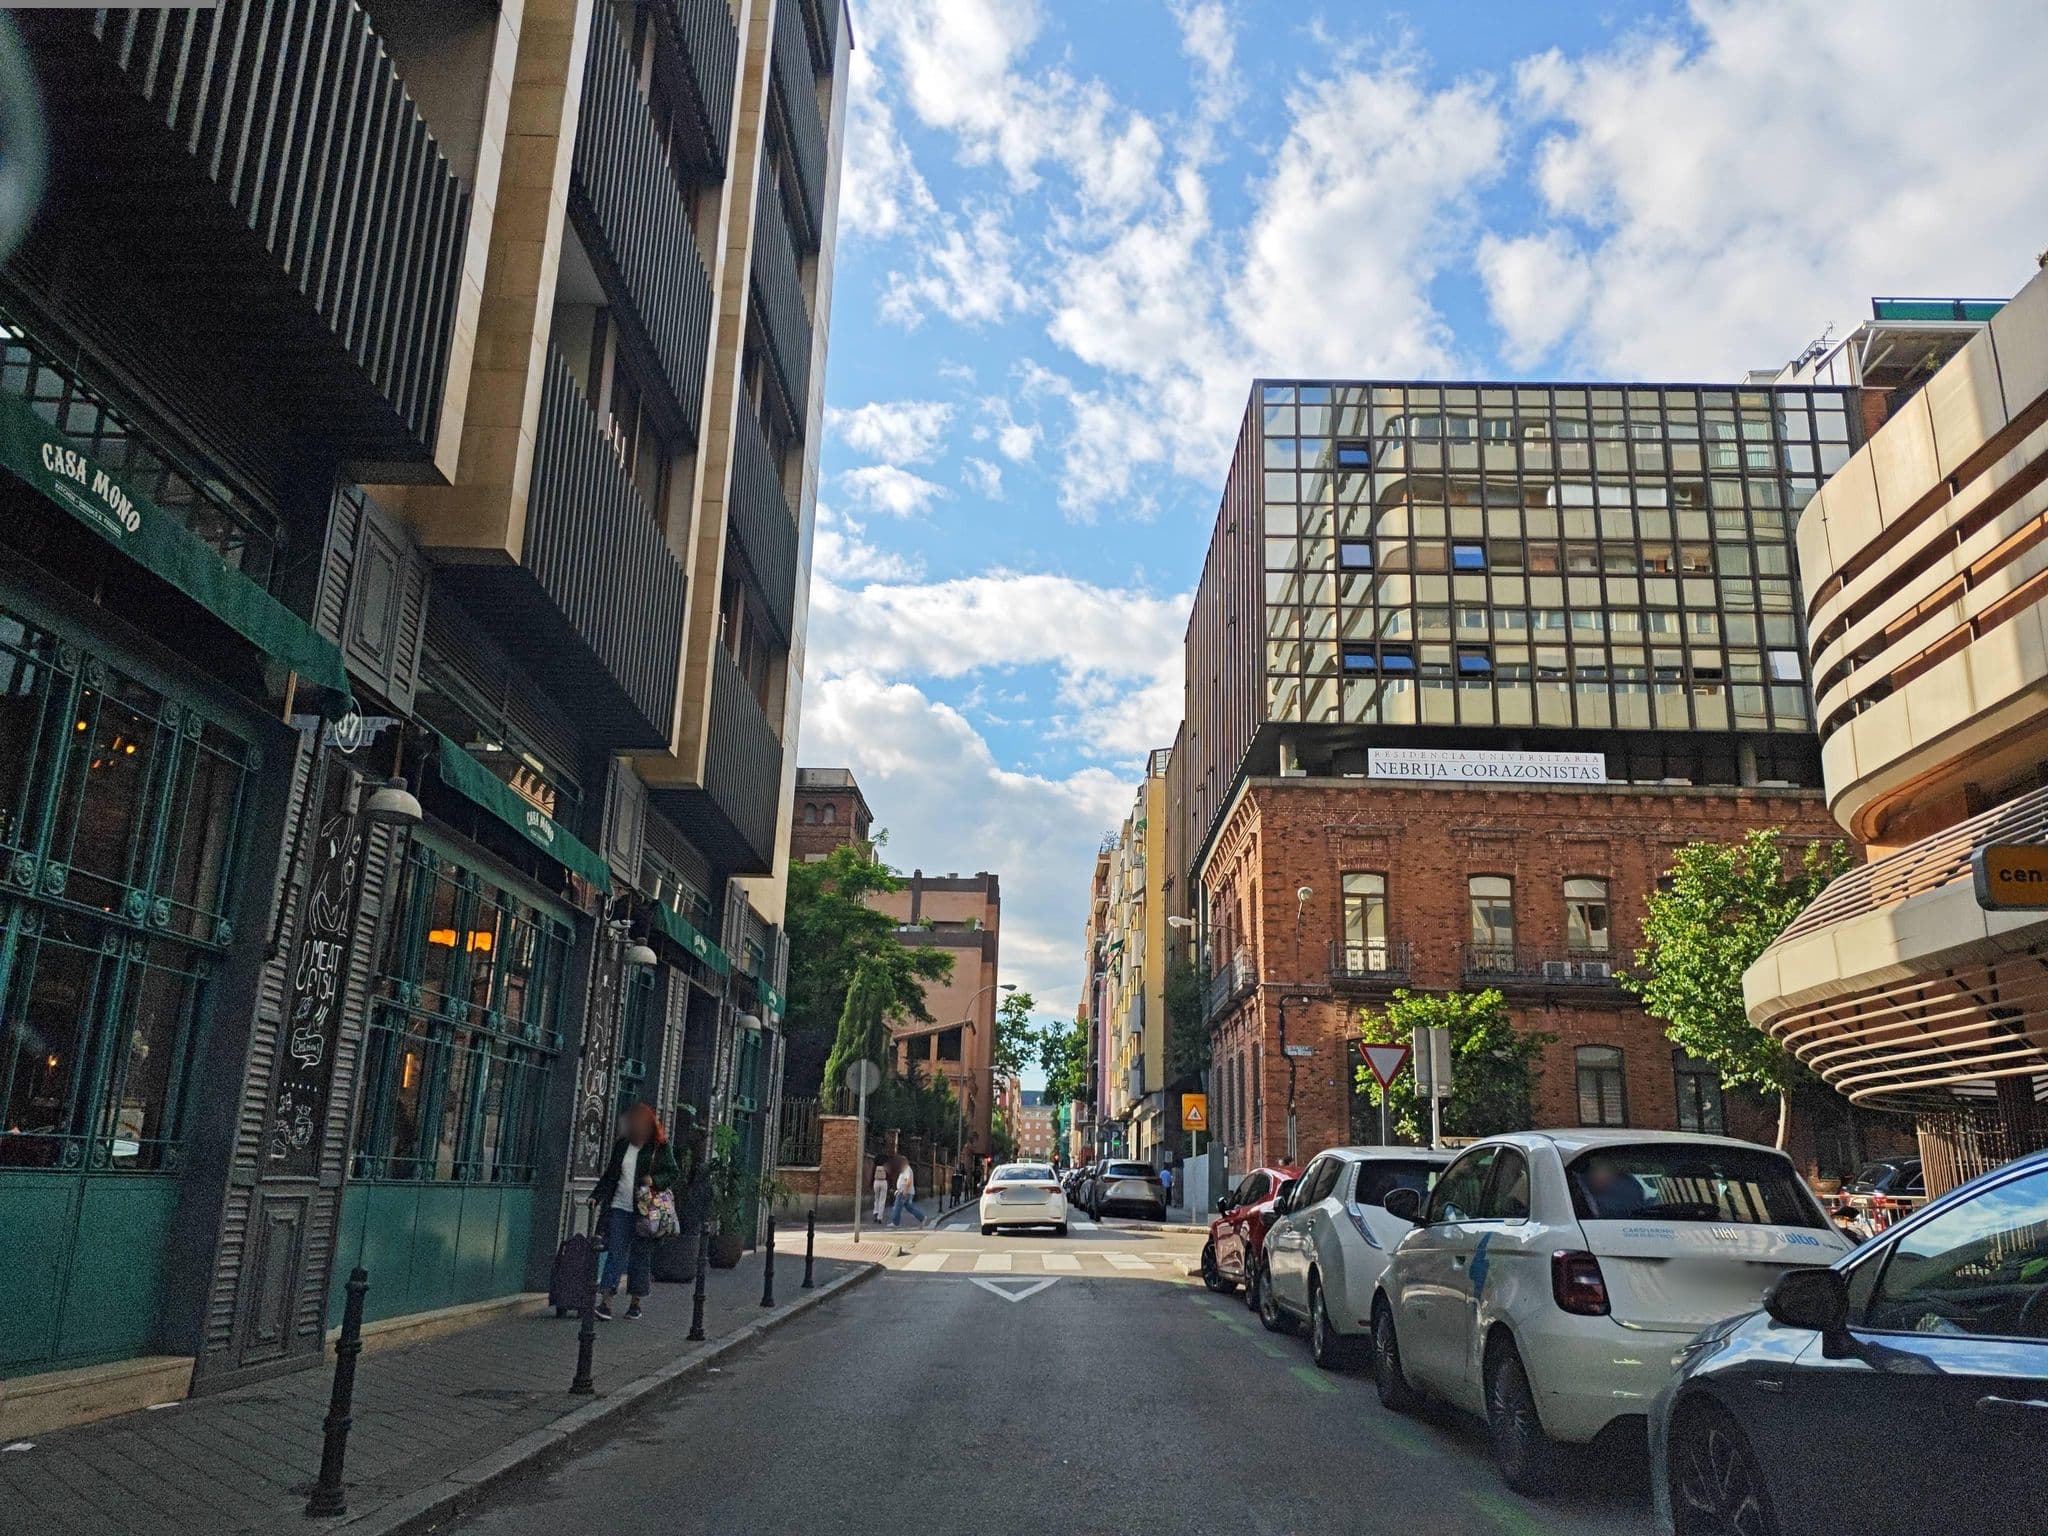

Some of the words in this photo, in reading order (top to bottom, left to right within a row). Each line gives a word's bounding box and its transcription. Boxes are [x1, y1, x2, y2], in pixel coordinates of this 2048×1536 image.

[42, 443, 87, 485] CASA
[91, 469, 141, 532] MONO
[1374, 751, 1466, 760] RESIDENCIA
[1479, 752, 1599, 763] UNIVERSITARIA
[1374, 762, 1448, 779] NEBRIJA
[1461, 763, 1600, 780] CORAZONISTAS
[2000, 868, 2048, 882] cen
[310, 940, 343, 974] MEAT
[305, 968, 337, 1006] FISH
[1711, 1226, 1739, 1241] FIAT
